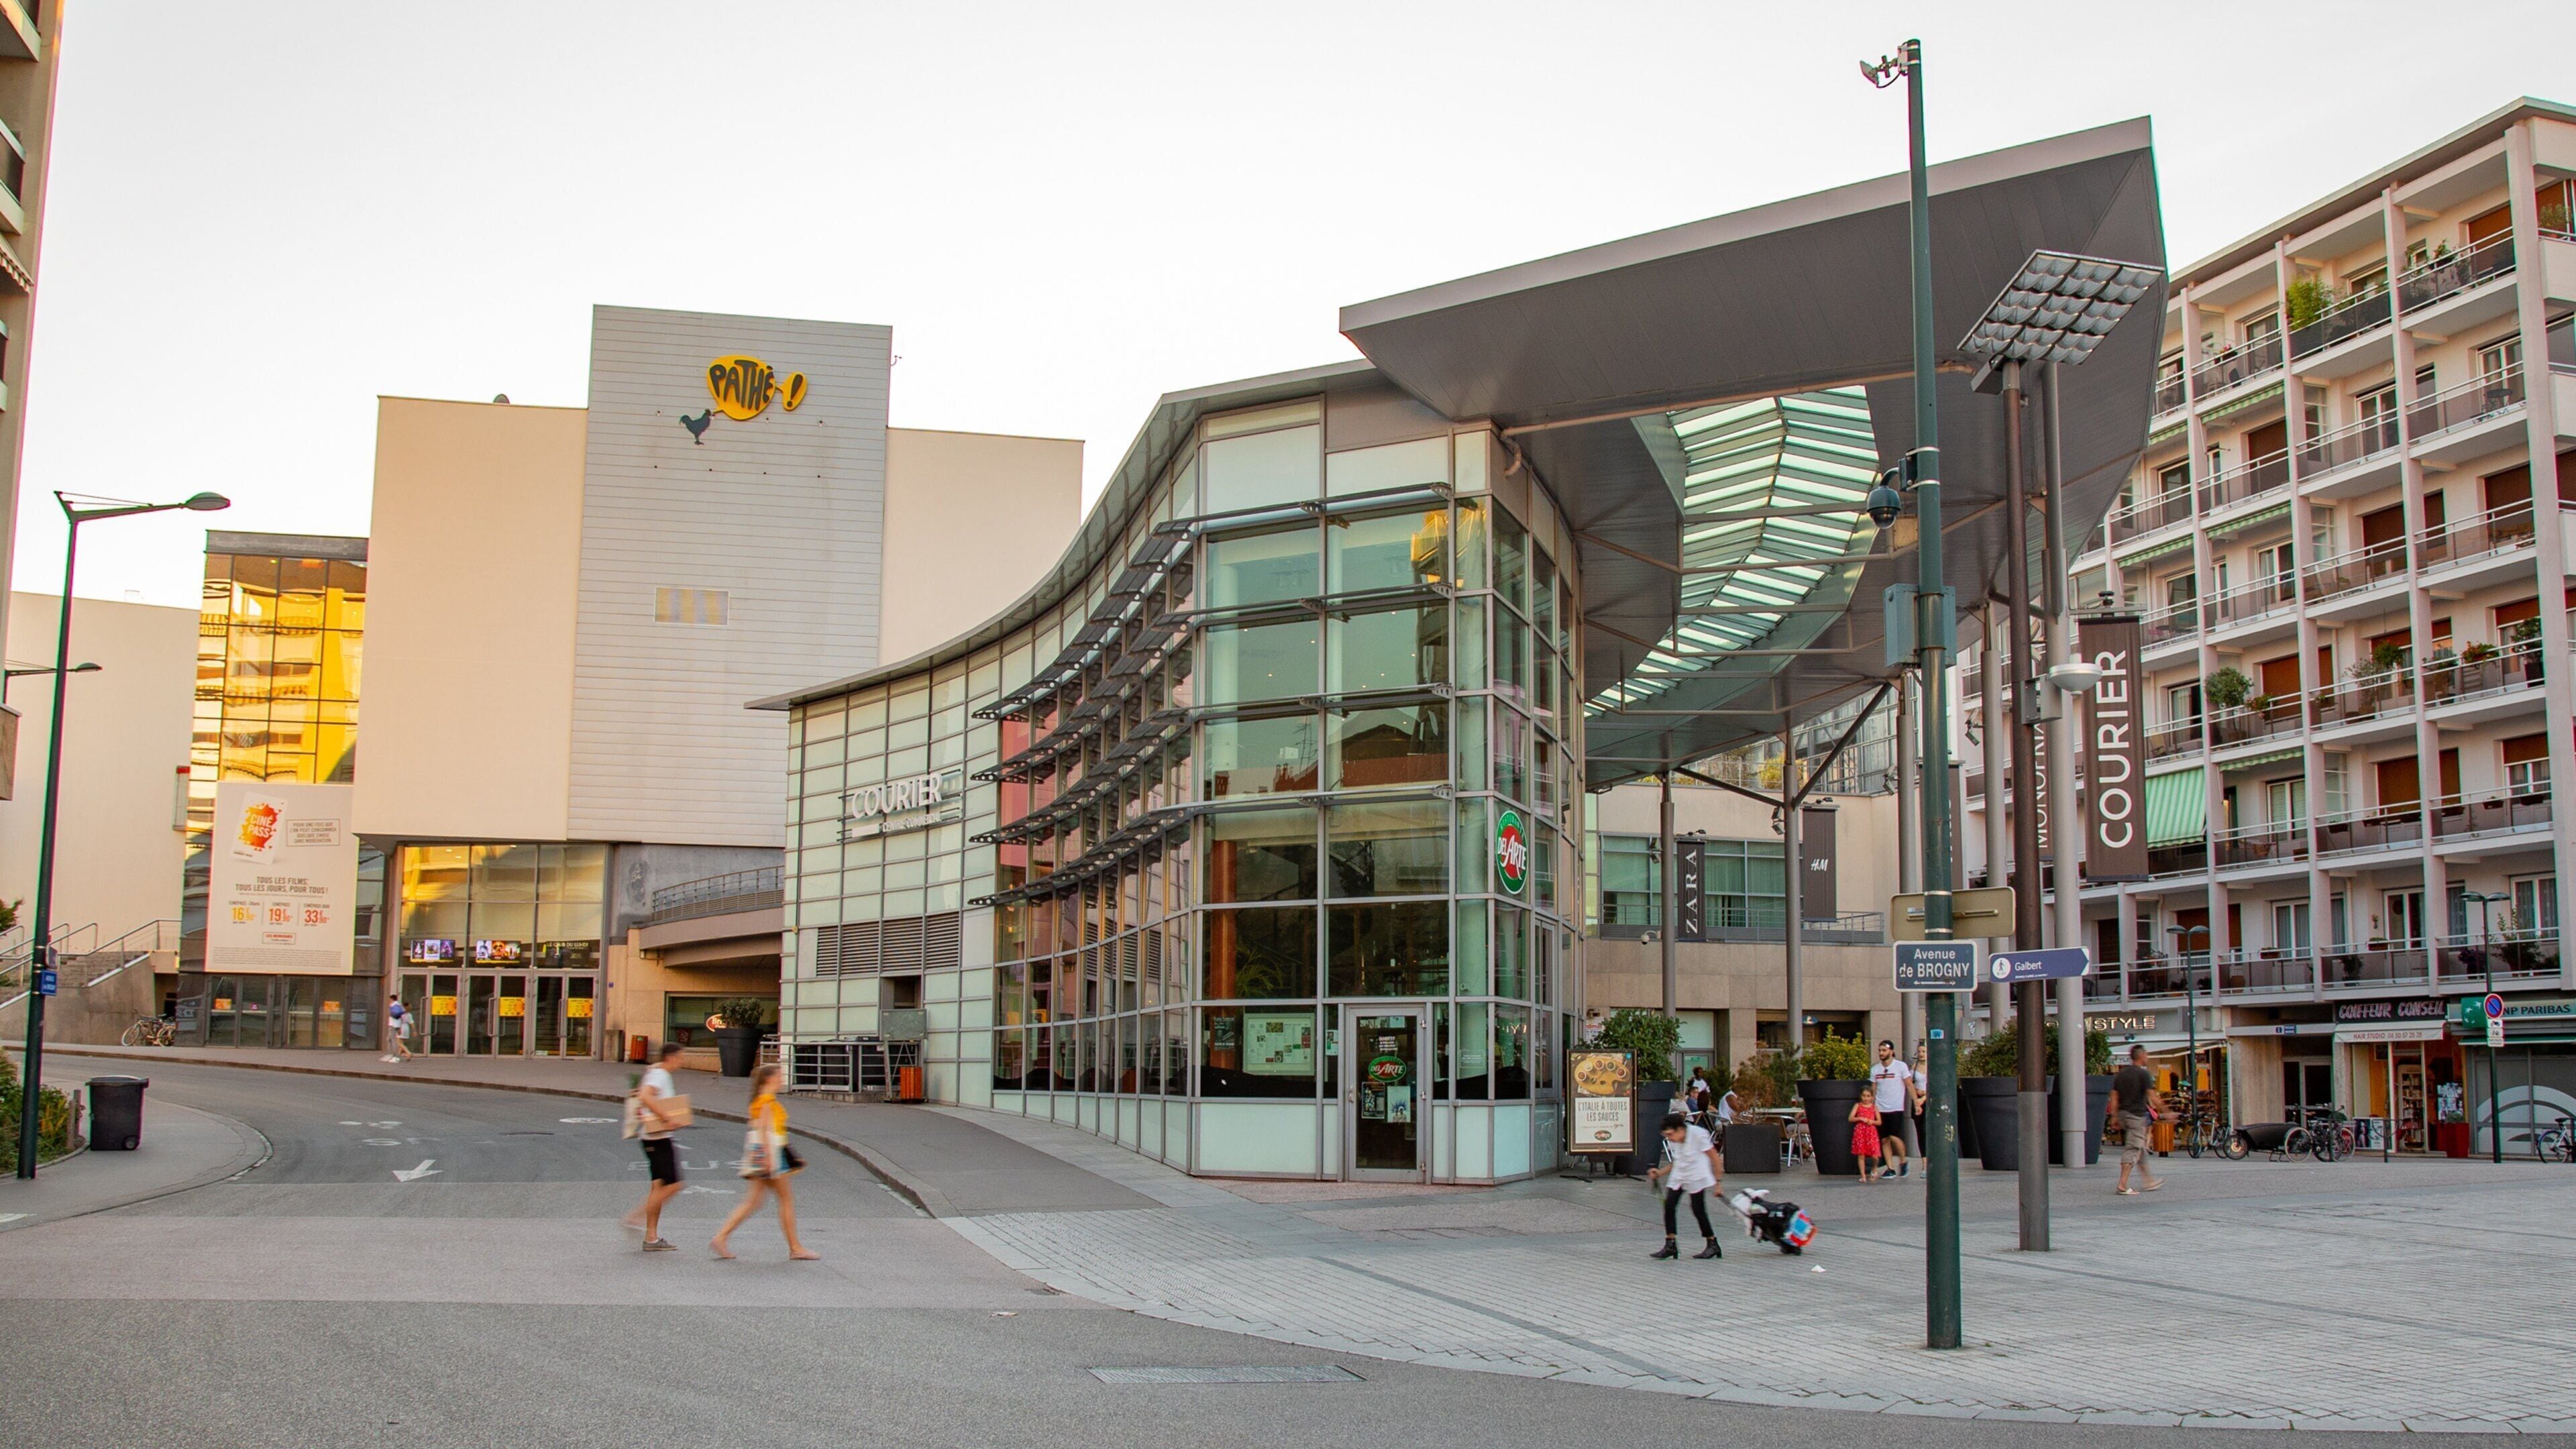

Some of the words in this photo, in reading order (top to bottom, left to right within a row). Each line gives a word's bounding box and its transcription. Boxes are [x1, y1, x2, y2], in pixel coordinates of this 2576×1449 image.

[709, 360, 775, 411] PATHÉ
[2094, 650, 2133, 848] COURIER
[852, 773, 943, 819] COURIER
[250, 813, 274, 827] CINÉ
[248, 825, 271, 838] PASS
[1497, 837, 1507, 856] DEL
[1499, 835, 1527, 880] ARTE
[1811, 858, 1829, 871] H&M
[1685, 849, 1698, 934] ZARA
[1914, 948, 1955, 959] Avenue
[1899, 963, 1913, 977] de
[1917, 963, 1970, 977] BROGNY
[2015, 961, 2042, 971] Galbert
[2339, 1002, 2392, 1019] COIFFEUR
[2398, 1000, 2445, 1017] CONSEIL
[2503, 1007, 2518, 1015] NP
[2521, 1004, 2571, 1015] PARIBAS
[2094, 1016, 2155, 1031] STYLE
[1374, 1063, 1404, 1077] ARTE
[1578, 1102, 1599, 1111] L'ITALIE
[1607, 1101, 1627, 1111] TOUTES
[1586, 1112, 1596, 1122] LES
[1597, 1112, 1619, 1122] SAUCES
